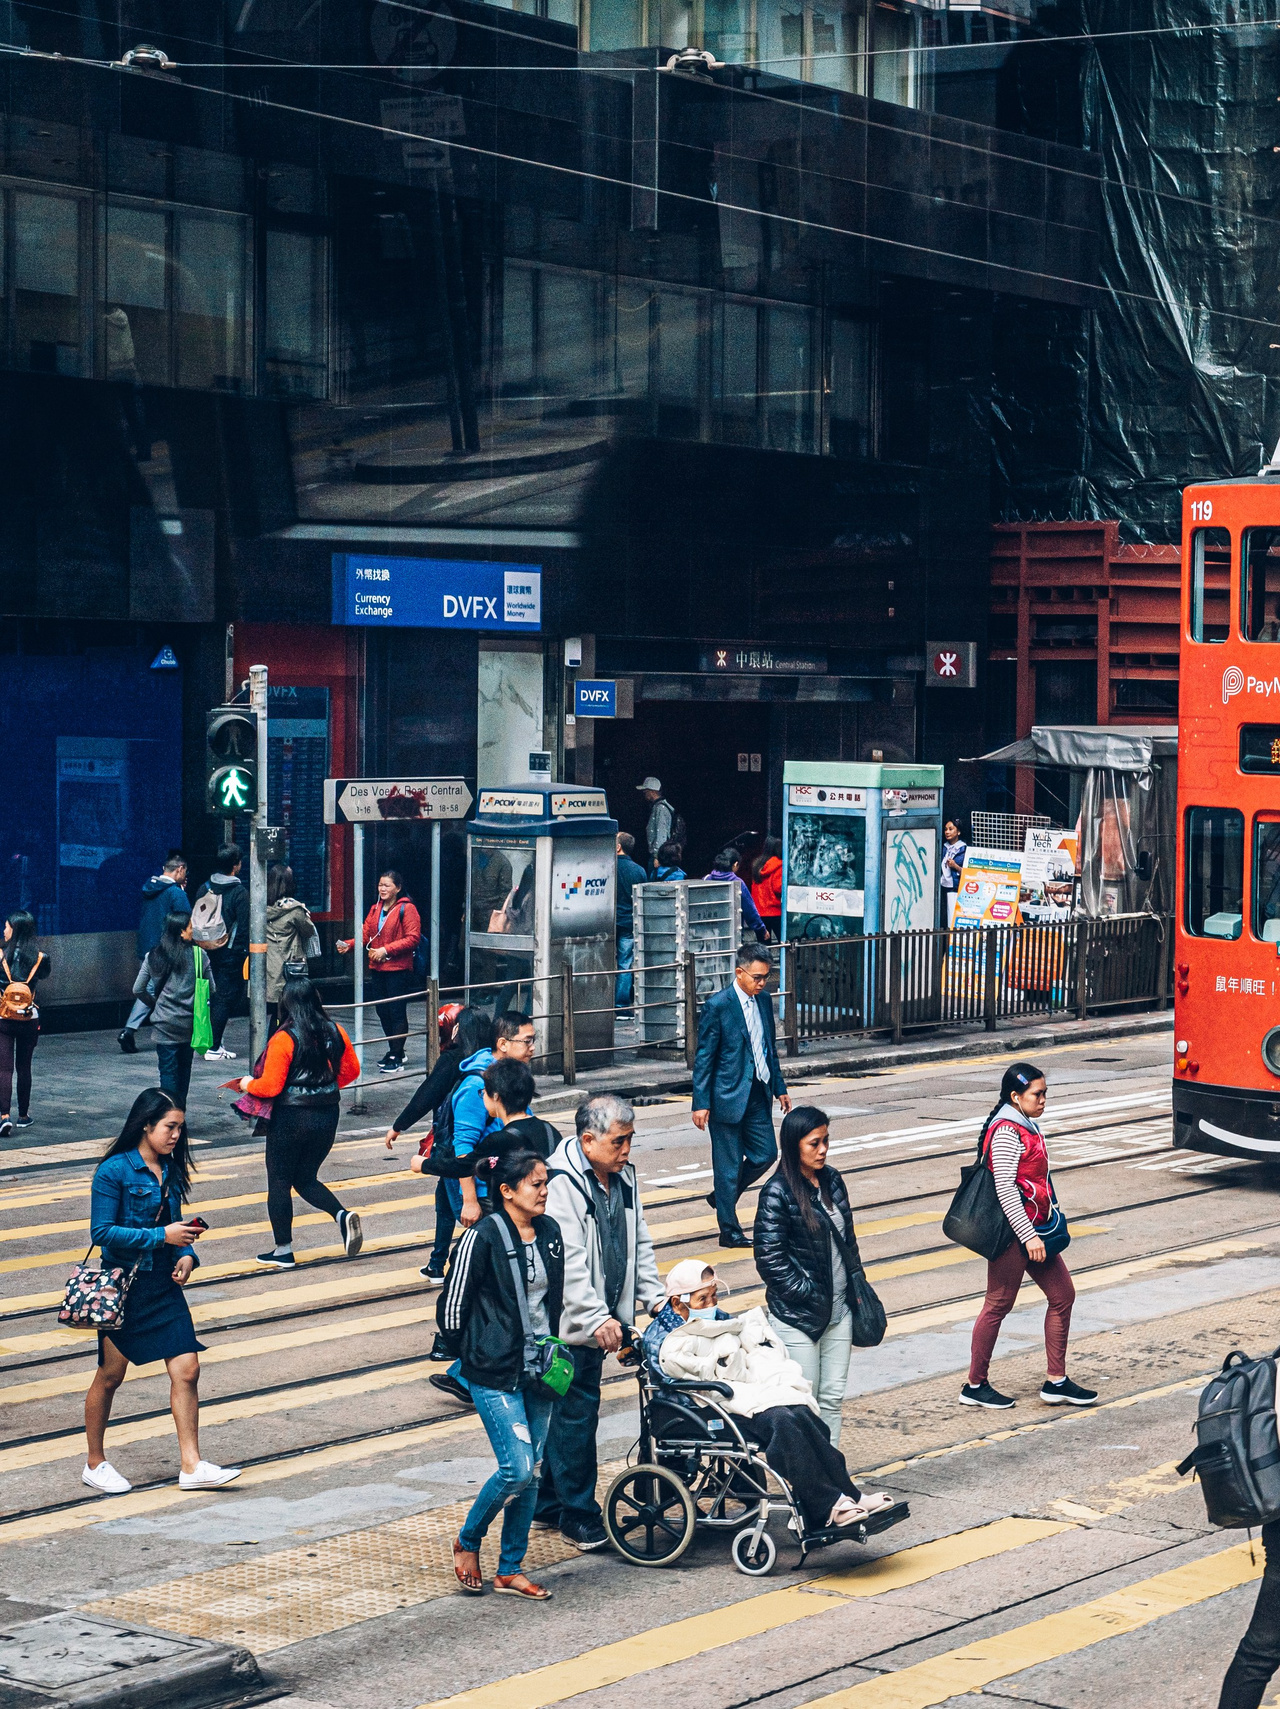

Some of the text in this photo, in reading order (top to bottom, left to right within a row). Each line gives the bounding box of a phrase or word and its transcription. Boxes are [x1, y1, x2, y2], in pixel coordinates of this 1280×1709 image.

[1190, 499, 1213, 521] 119
[355, 568, 390, 581] 外幣找換
[355, 592, 391, 606] Currency
[443, 594, 498, 620] DVFX
[506, 601, 536, 610] Worldwide
[355, 605, 393, 618] Exchange
[506, 610, 526, 618] Money
[735, 650, 773, 669] 中環站
[775, 660, 816, 670] Central Station
[580, 689, 610, 702] DVFX
[350, 786, 369, 797] Des
[430, 784, 463, 796] Central
[795, 786, 812, 794] HGC
[908, 793, 936, 801] PAYPHONE
[438, 804, 459, 812] 18-58
[494, 799, 516, 807] PCCW
[568, 800, 587, 808] PCCW
[1033, 840, 1052, 849] Tech
[585, 878, 607, 888] PCCW
[815, 891, 835, 902] HGC
